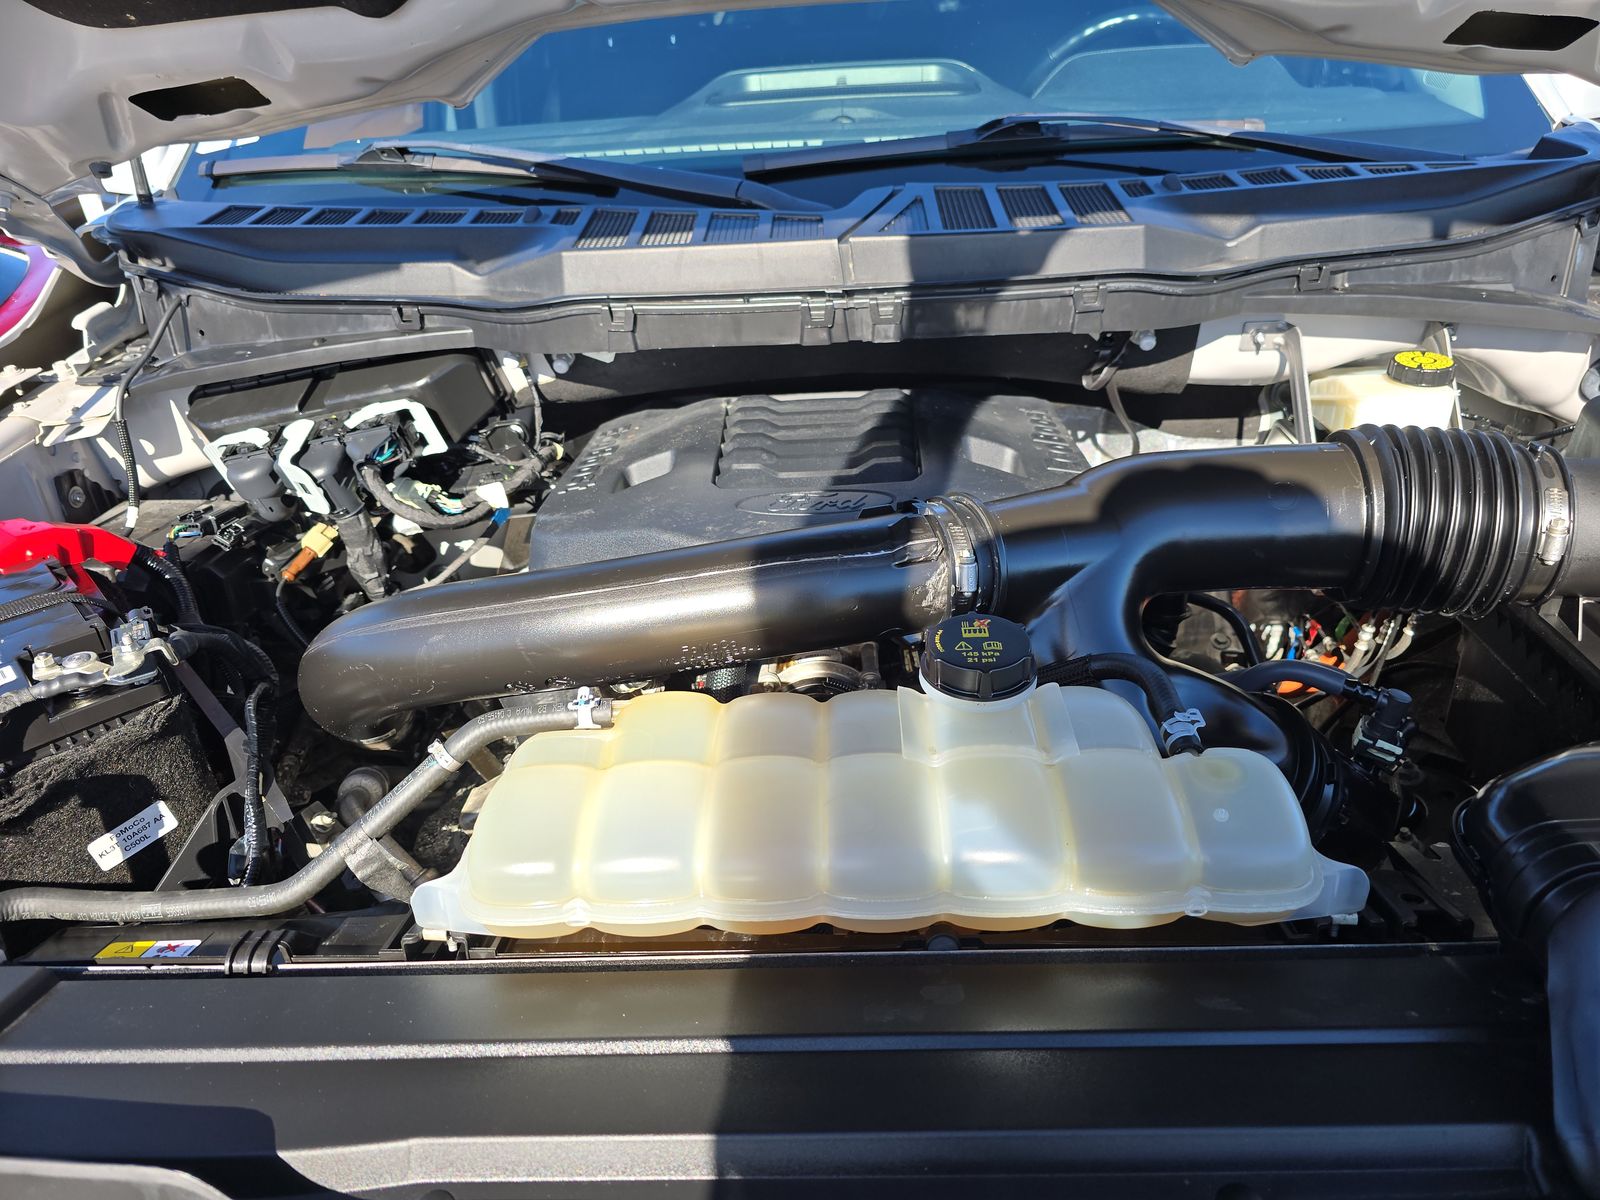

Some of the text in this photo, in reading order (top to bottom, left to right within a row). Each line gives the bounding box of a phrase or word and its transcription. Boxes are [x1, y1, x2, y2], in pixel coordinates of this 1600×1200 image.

[767, 492, 868, 512] Ford
[153, 813, 166, 824] AA
[109, 817, 146, 842] FoMoCo
[124, 833, 151, 852] C500L
